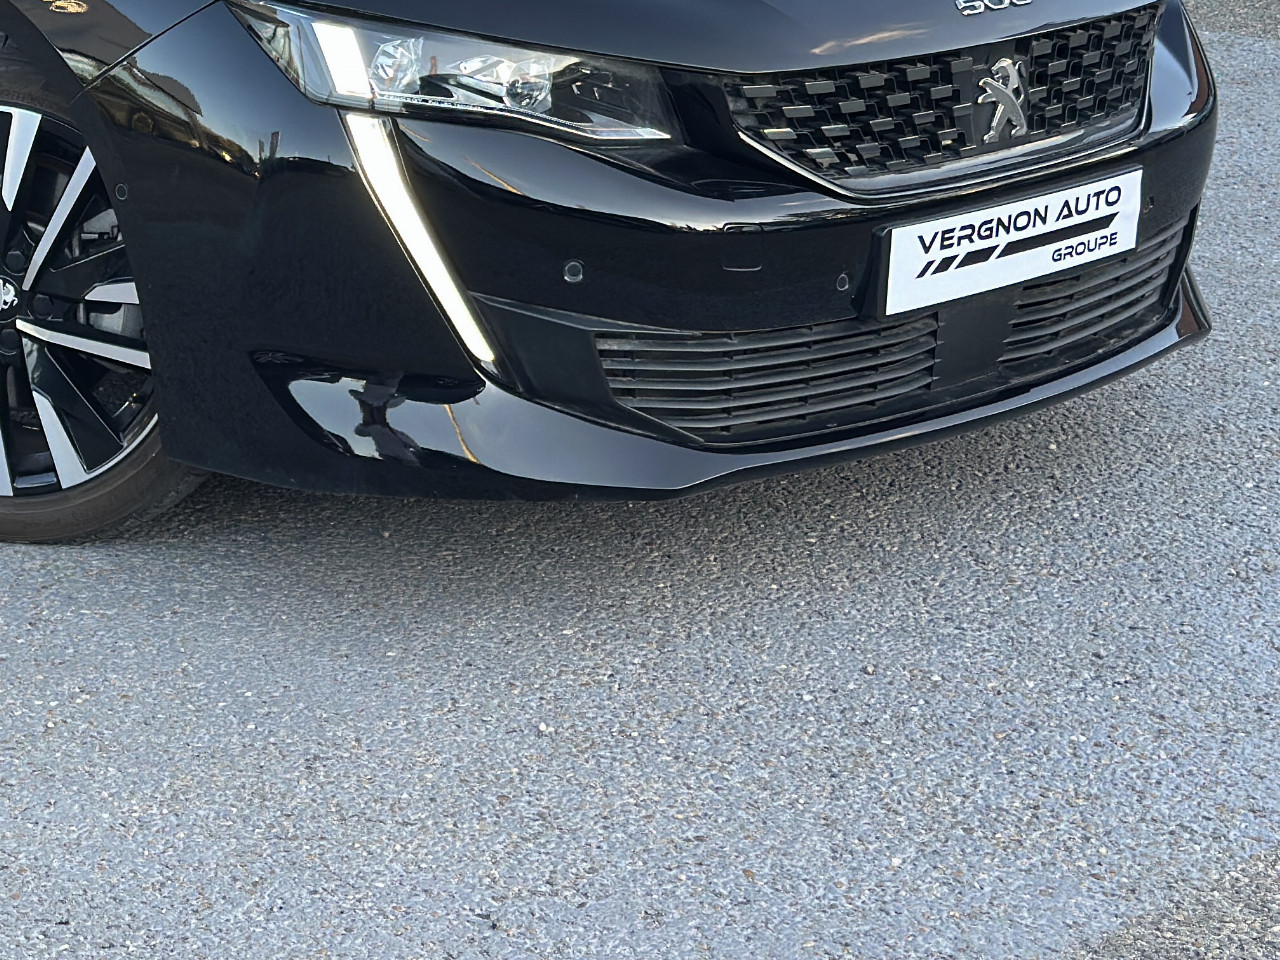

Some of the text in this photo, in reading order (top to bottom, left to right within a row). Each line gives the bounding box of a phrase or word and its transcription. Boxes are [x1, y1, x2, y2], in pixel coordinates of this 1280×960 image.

[916, 185, 1122, 255] VERGNON AUTO
[1051, 231, 1118, 263] GROUPE
